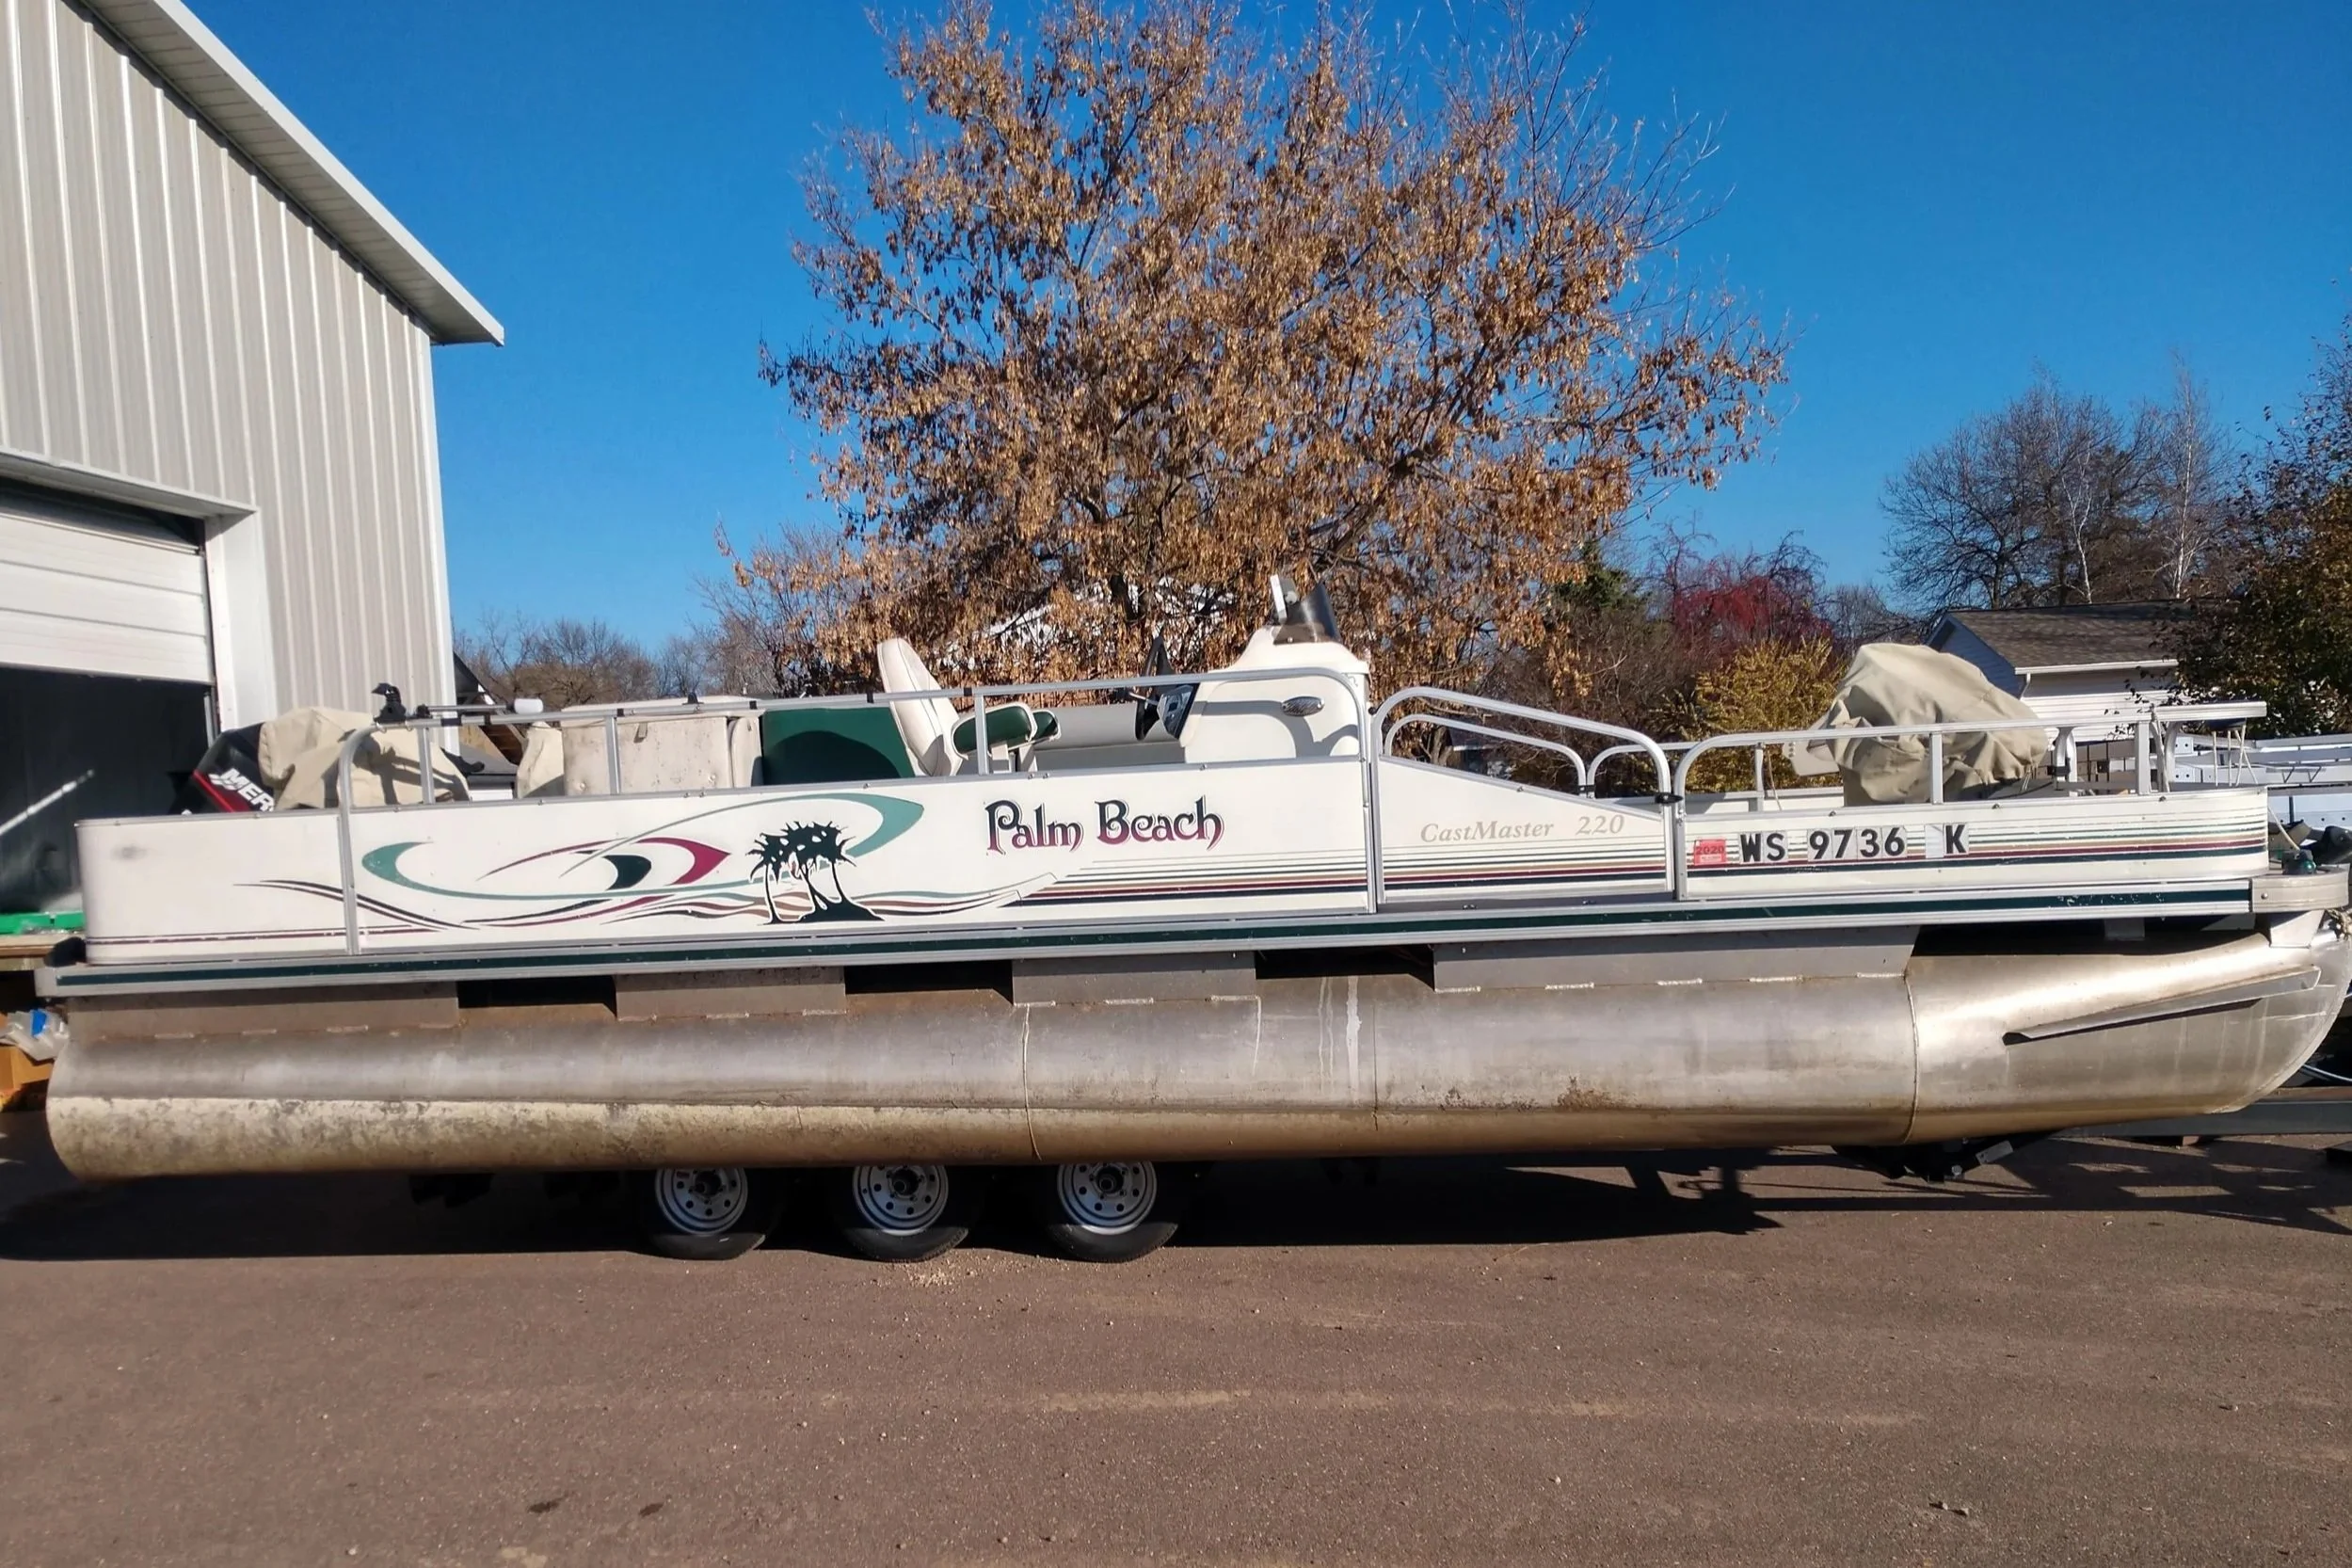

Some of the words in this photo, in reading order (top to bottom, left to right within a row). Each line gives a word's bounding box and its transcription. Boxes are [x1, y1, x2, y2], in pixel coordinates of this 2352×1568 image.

[208, 768, 275, 812] MER
[984, 800, 1084, 855] Palm
[1094, 795, 1224, 851] Beach
[1420, 820, 1554, 843] CastMaster
[1576, 814, 1625, 836] 220
[1740, 833, 1786, 862] WS
[1809, 826, 1905, 859] 9736
[1945, 824, 1967, 854] K
[1695, 845, 1725, 856] 2020
